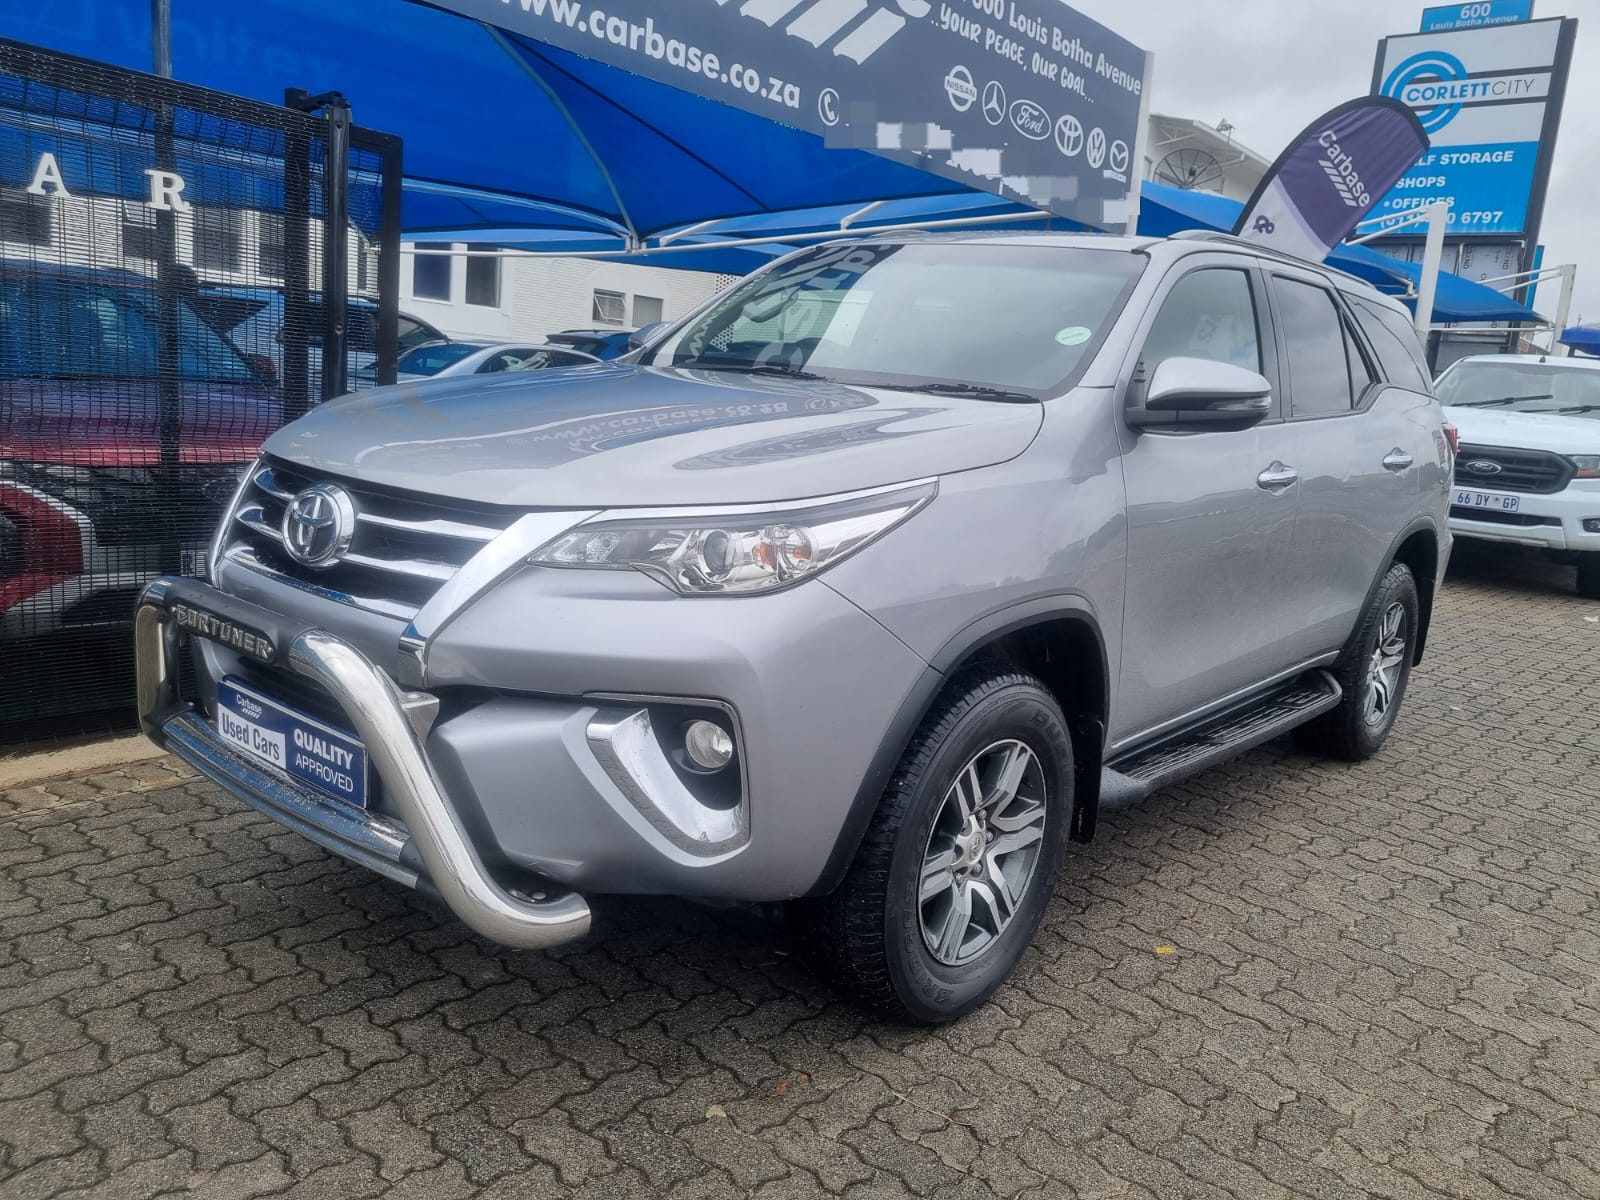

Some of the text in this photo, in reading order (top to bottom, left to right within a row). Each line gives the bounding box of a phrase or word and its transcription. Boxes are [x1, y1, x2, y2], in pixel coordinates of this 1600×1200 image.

[1430, 15, 1519, 31] Louis Botha Avenue
[1461, 3, 1491, 19] 600
[500, 0, 800, 109] ww.carbase.co.za
[985, 27, 1027, 71] PEACE,
[1032, 52, 1058, 81] OUR
[1009, 2, 1048, 45] Louis
[1052, 27, 1092, 69] Botha
[1095, 53, 1141, 95] Avenue
[949, 79, 976, 98] NISSAN
[1406, 78, 1535, 102] CORLETT CITY
[1017, 105, 1045, 134] Ford
[1318, 130, 1370, 207] Carbase
[1440, 150, 1515, 165] STORAGE
[27, 152, 192, 213] A R
[1395, 176, 1446, 189] SHOPS
[1461, 211, 1505, 224] 6797
[1475, 494, 1490, 507] DY
[1503, 497, 1517, 510] GP
[176, 603, 268, 659] FORTUNER
[236, 694, 263, 715] Carbase
[222, 712, 280, 761] Used Cars
[294, 728, 354, 770] QUALITY
[295, 753, 354, 793] APPROVED
